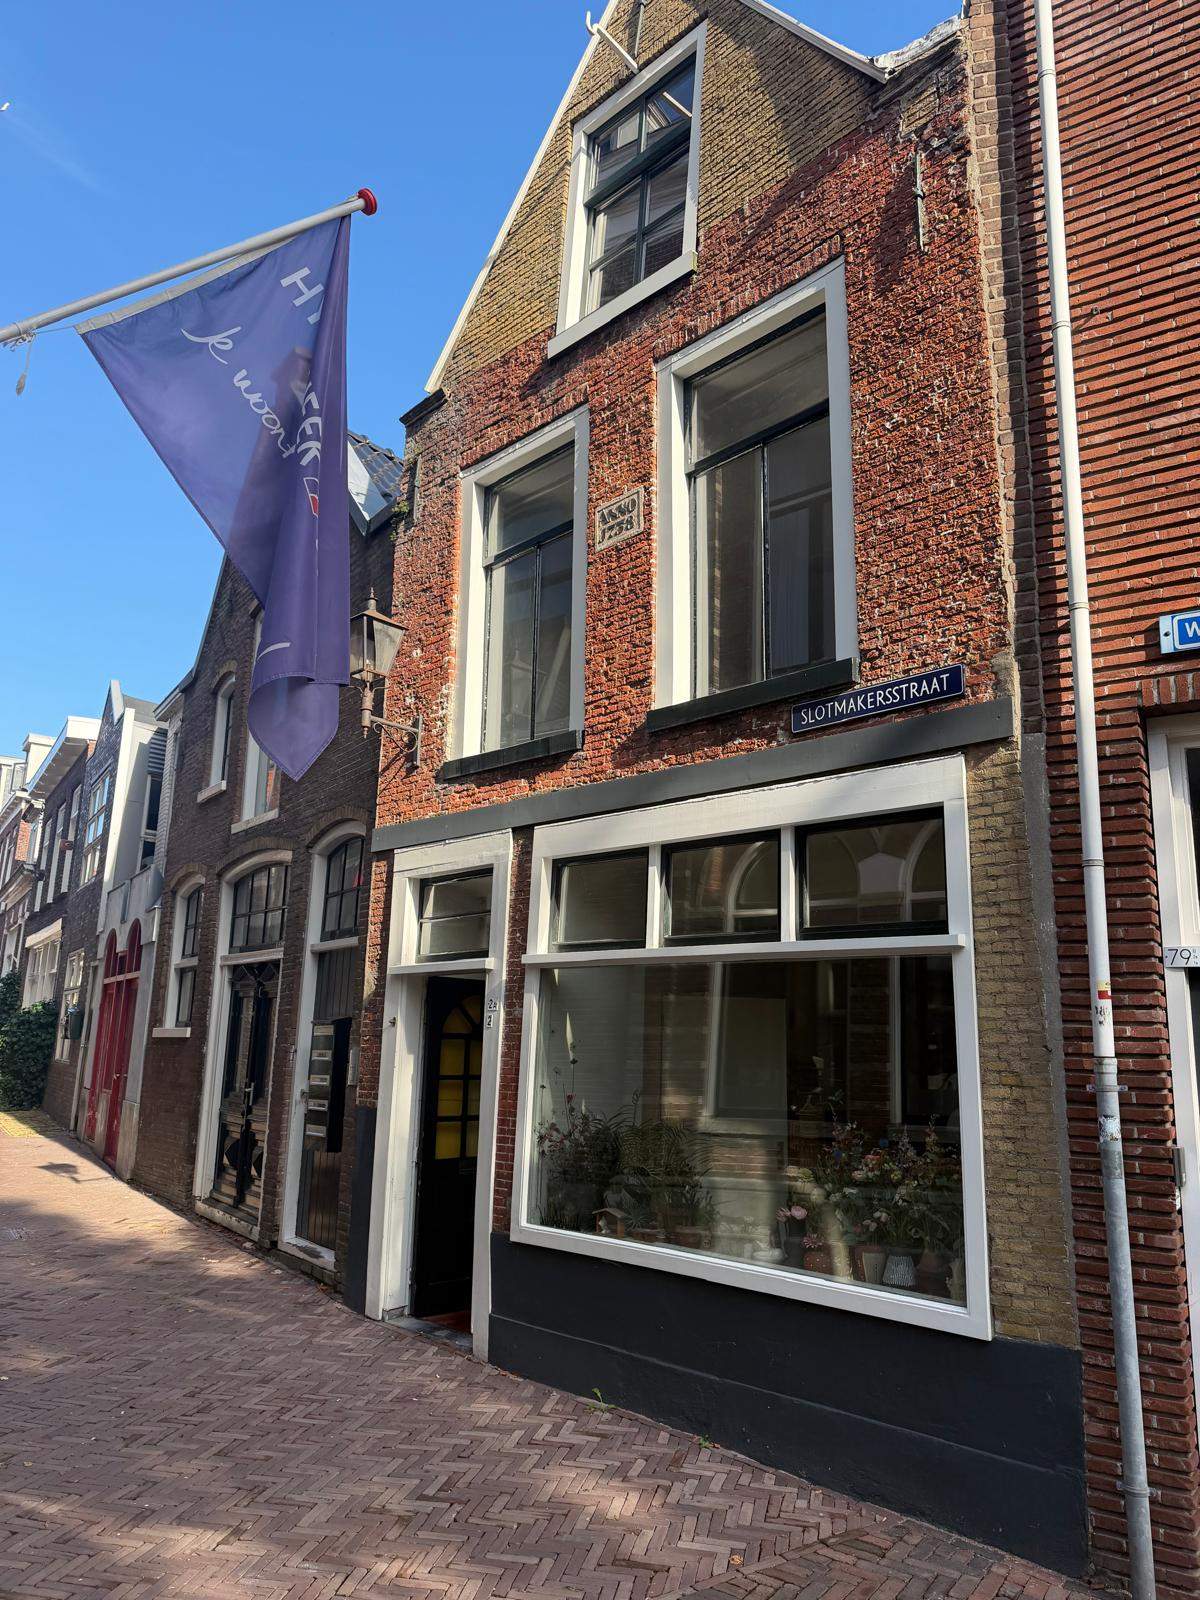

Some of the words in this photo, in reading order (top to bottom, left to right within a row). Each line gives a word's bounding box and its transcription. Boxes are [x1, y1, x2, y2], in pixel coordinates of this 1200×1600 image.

[599, 497, 638, 526] ANNO
[801, 673, 950, 725] SLOTMAKERSSTRAAT
[1168, 948, 1192, 966] 79
